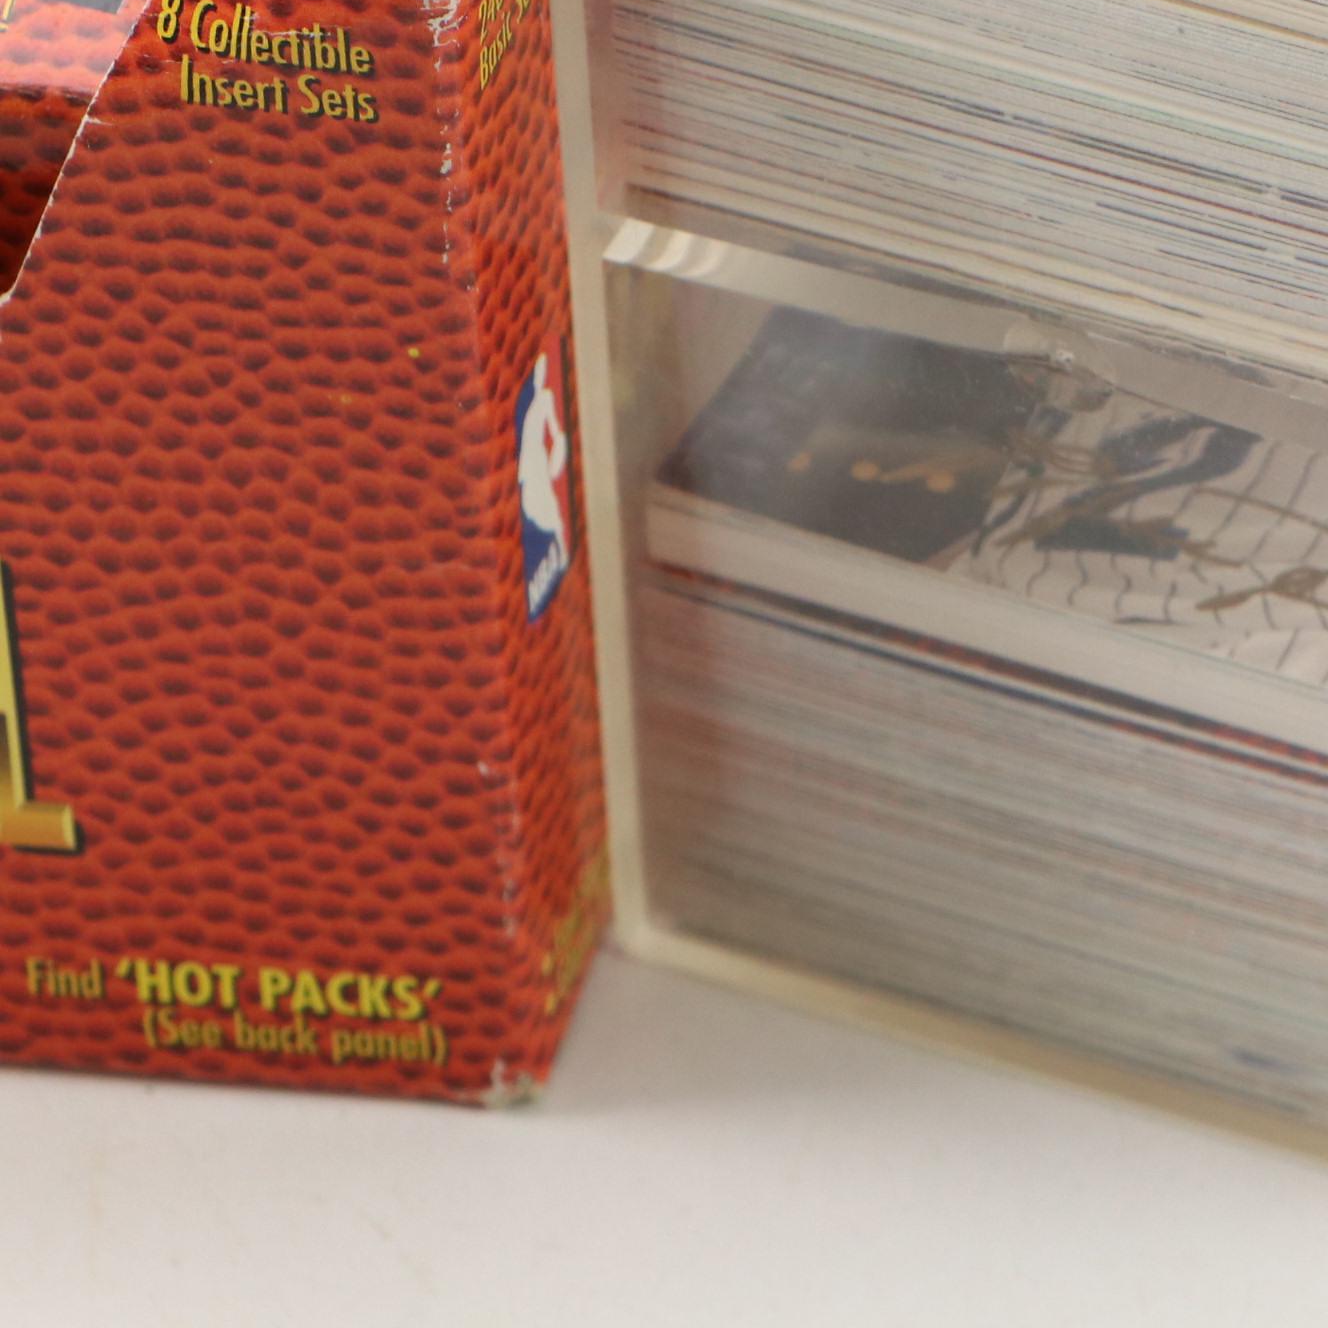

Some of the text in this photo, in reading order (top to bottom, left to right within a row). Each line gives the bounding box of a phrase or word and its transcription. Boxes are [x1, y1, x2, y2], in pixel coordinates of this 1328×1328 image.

[479, 10, 513, 91] Basic
[181, 53, 378, 122] Insert Sets
[527, 539, 559, 615] NBA
[26, 956, 103, 999] Find
[143, 1003, 449, 1066] (See back panel)
